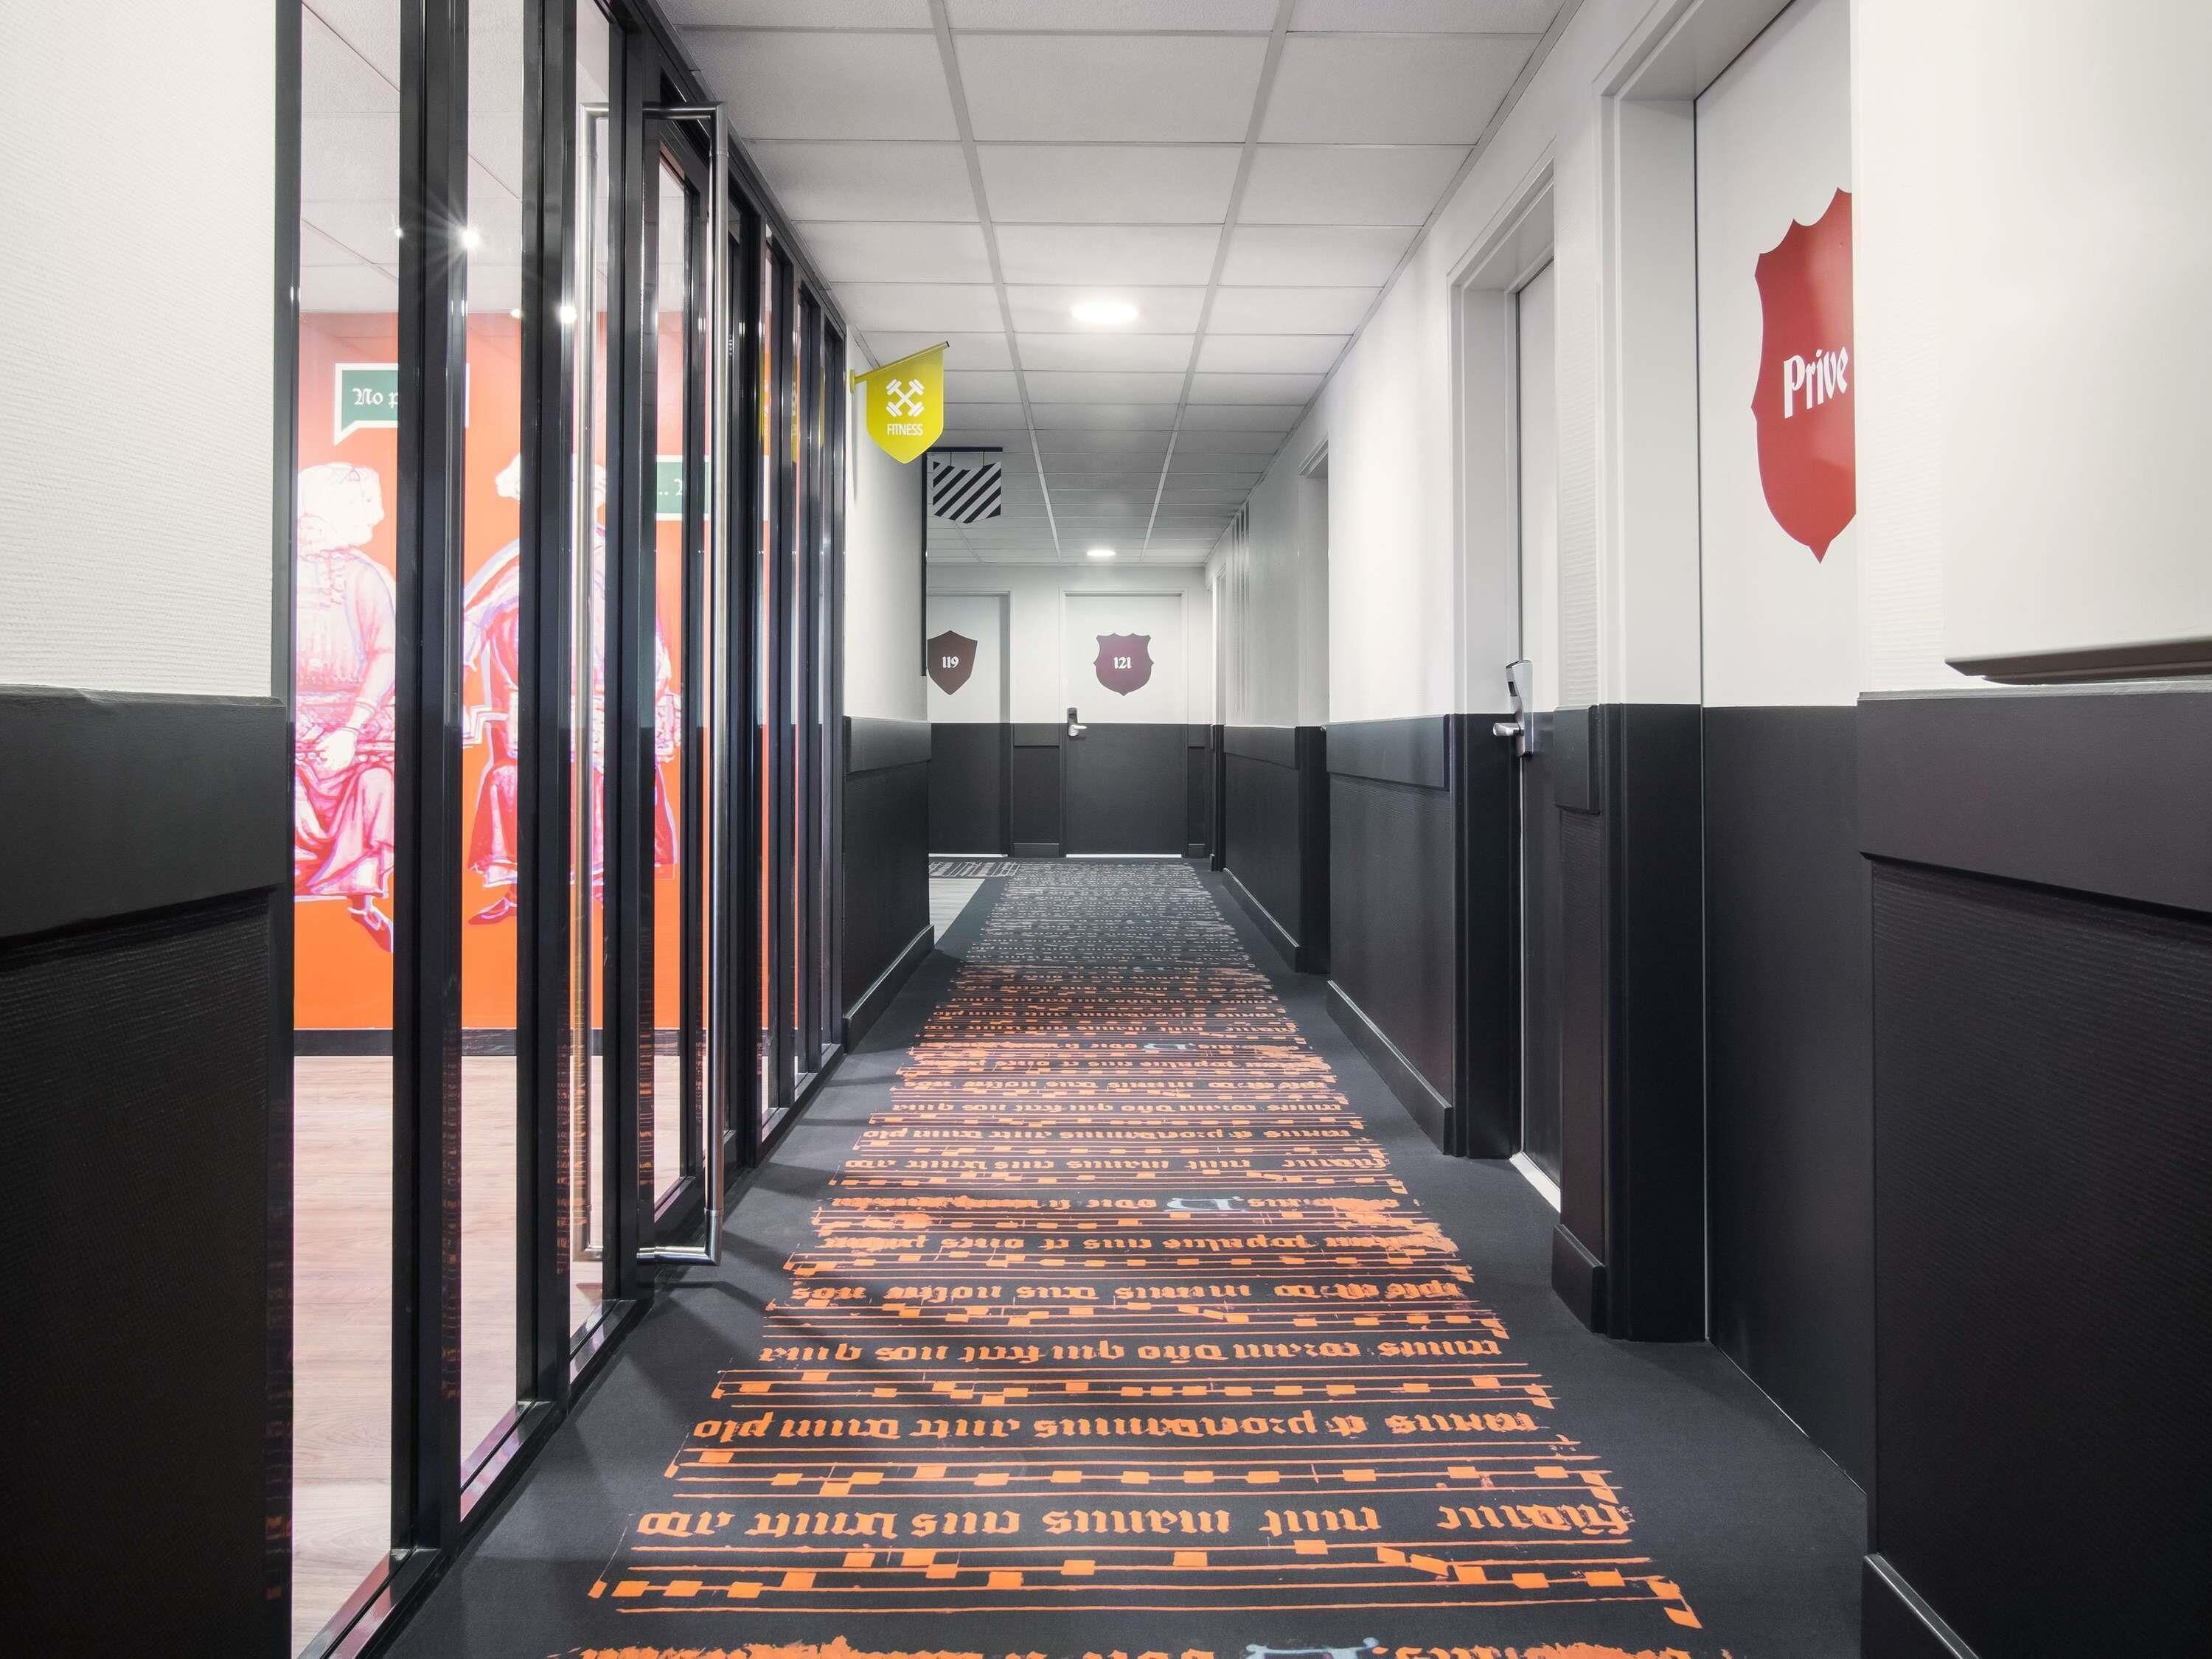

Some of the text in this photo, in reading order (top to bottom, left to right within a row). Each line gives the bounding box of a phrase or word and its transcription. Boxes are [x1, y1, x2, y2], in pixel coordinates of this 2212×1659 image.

[1784, 346, 1848, 419] Prive
[352, 388, 383, 405] No
[887, 423, 923, 436] FITNESS
[942, 656, 959, 668] 119
[1113, 656, 1132, 669] 121
